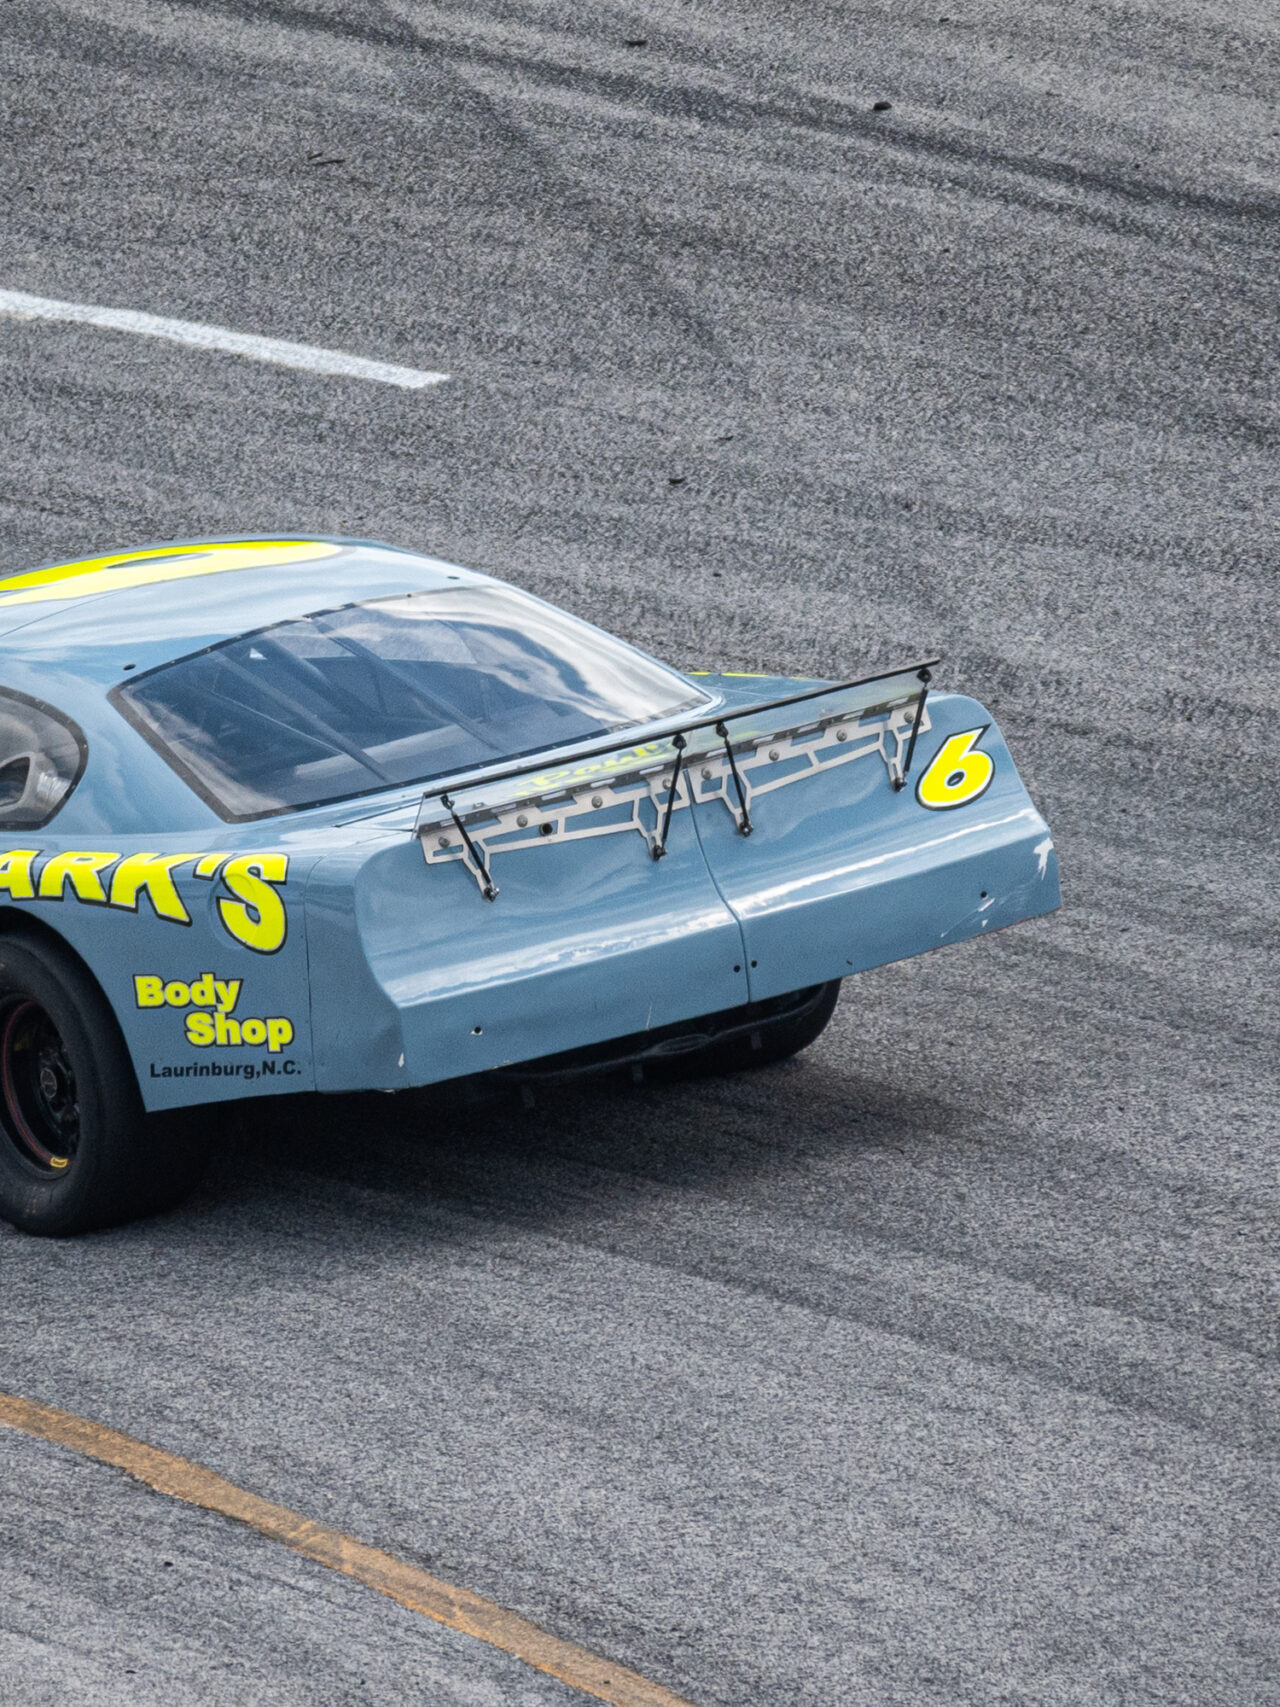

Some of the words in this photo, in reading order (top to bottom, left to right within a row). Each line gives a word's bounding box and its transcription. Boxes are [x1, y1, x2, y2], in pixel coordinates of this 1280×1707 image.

[915, 723, 996, 811] 6
[133, 972, 243, 1013] Body
[185, 1011, 295, 1053] Shop
